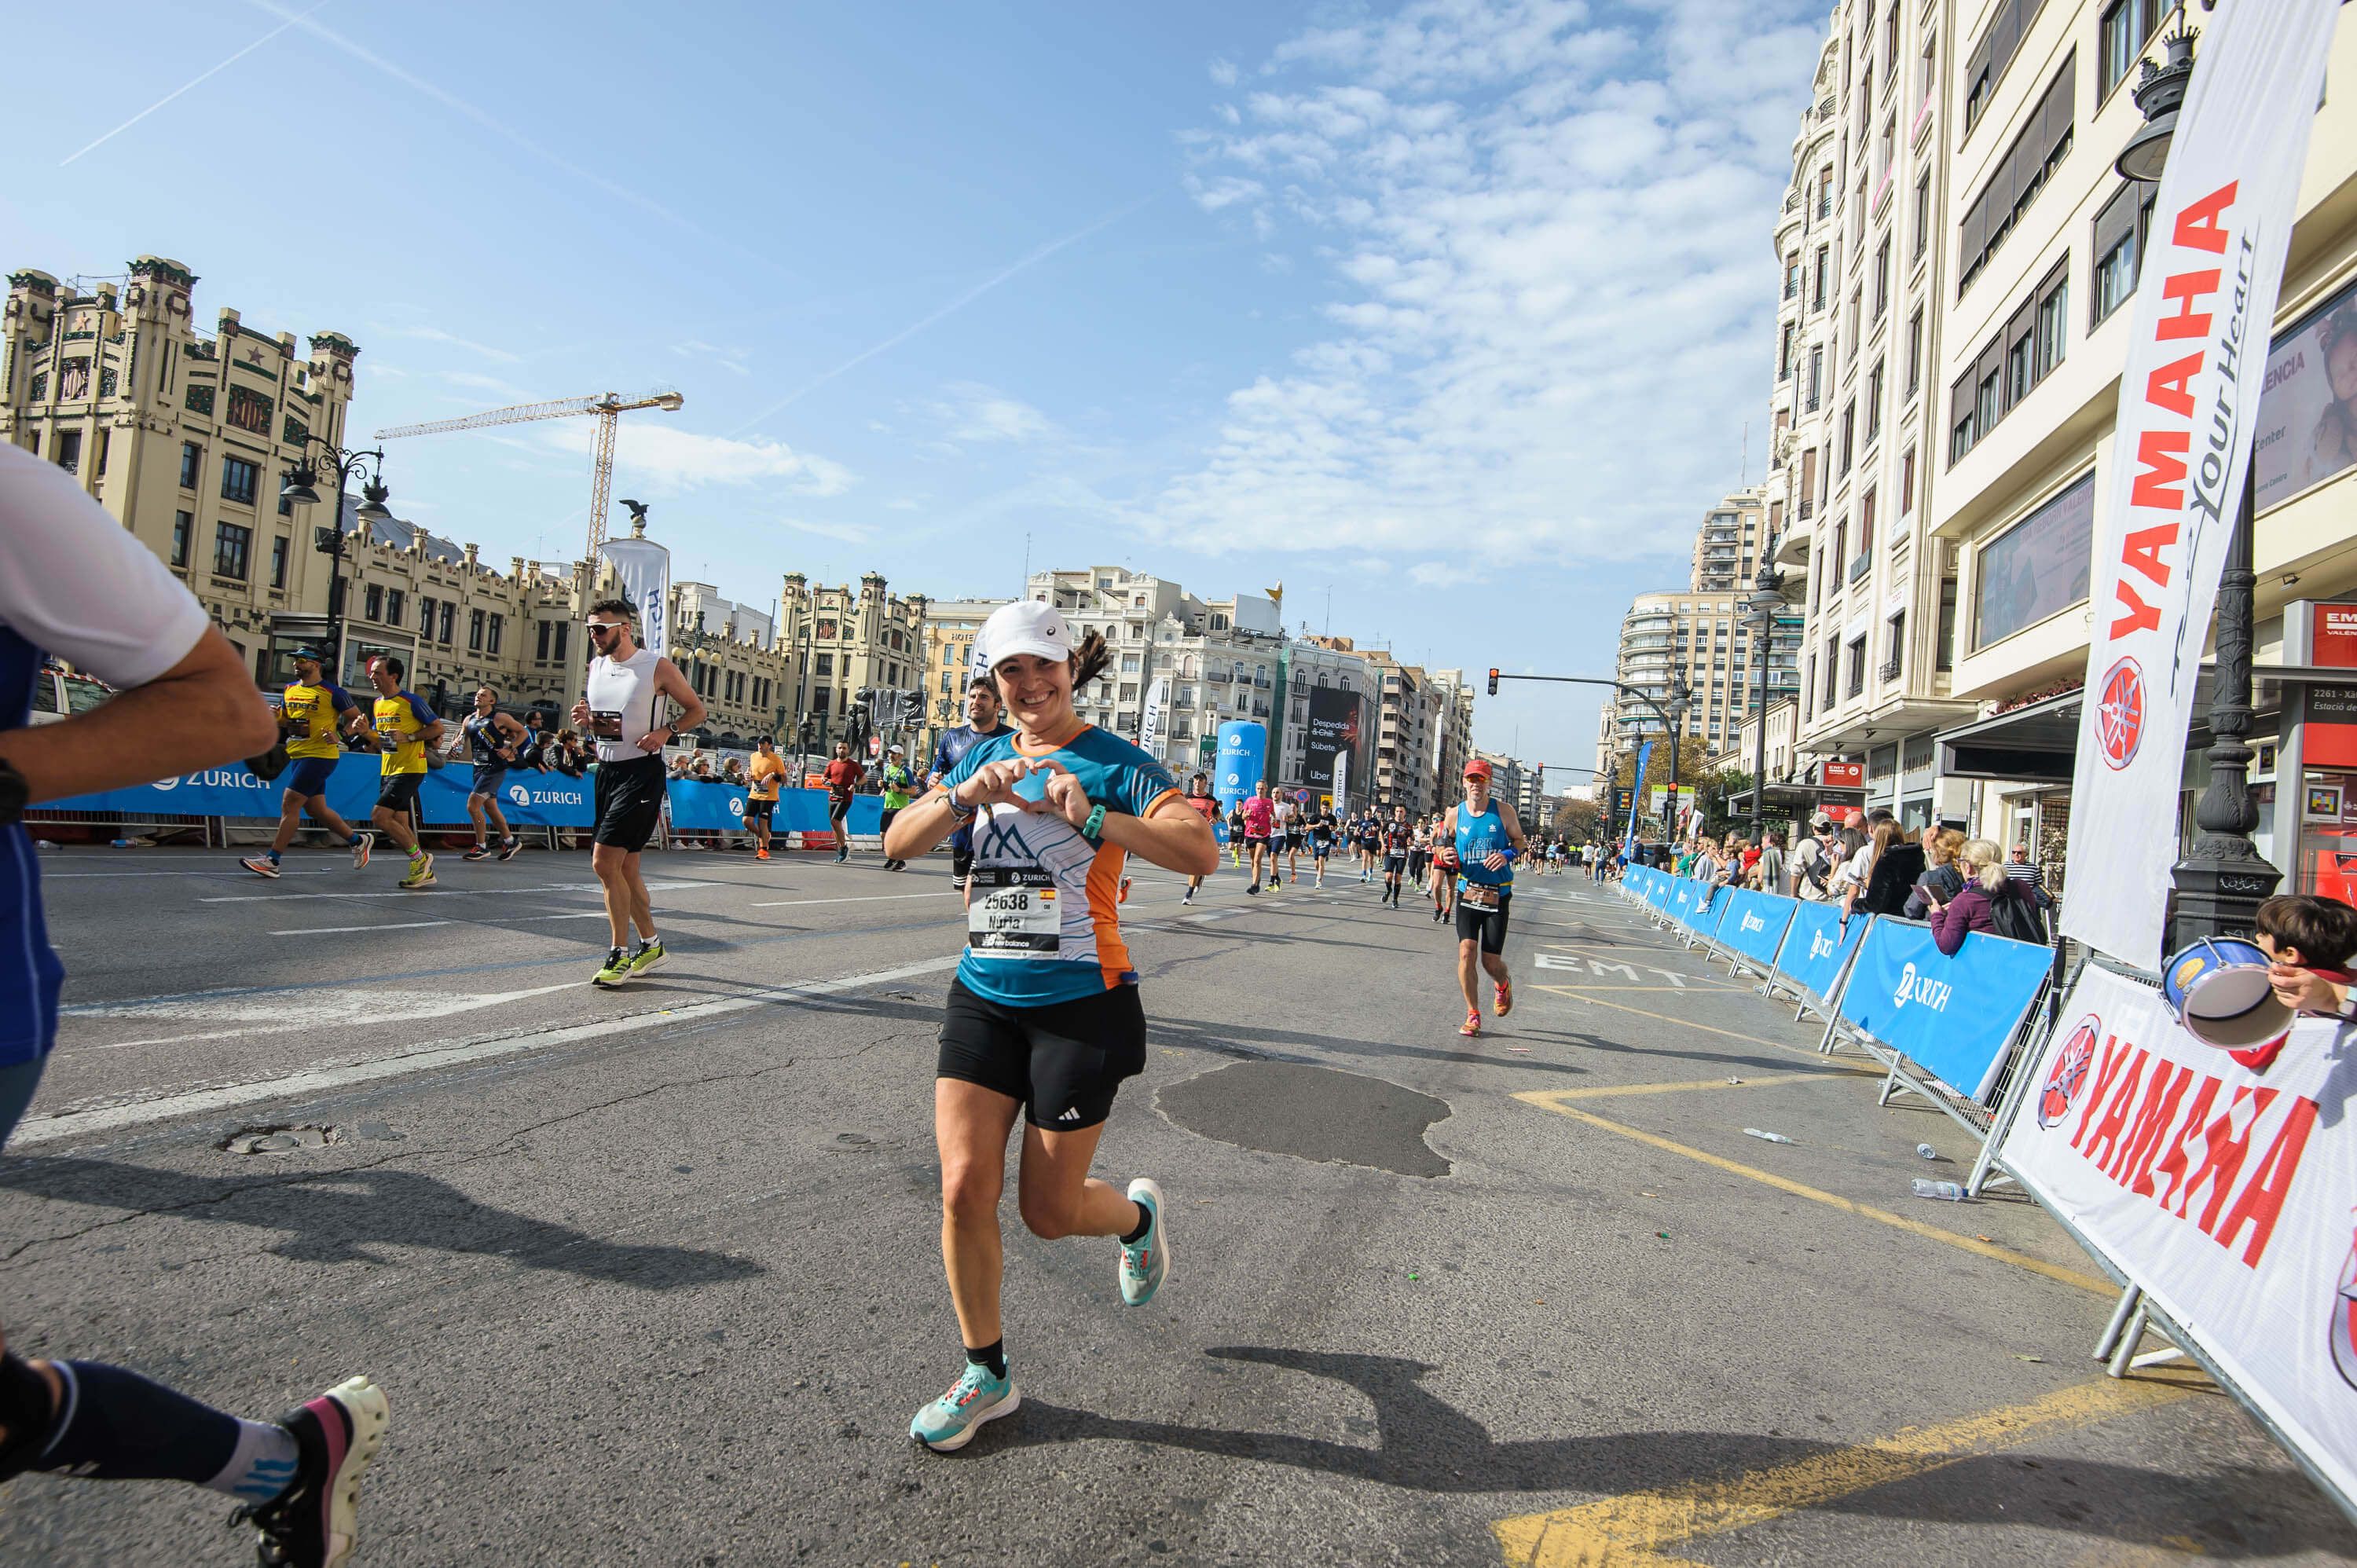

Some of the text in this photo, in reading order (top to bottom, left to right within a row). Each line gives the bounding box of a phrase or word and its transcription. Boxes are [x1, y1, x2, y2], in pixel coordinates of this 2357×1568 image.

[2218, 226, 2253, 383] Heart
[2109, 179, 2239, 641] YAMAHA
[2326, 613, 2357, 622] EM
[951, 633, 974, 642] HOTE
[2314, 689, 2336, 698] 2261
[2314, 702, 2344, 711] Estació
[1313, 718, 1350, 731] Despedida
[1222, 748, 1251, 757] ZURICH
[1310, 770, 1330, 781] Uber
[532, 790, 582, 805] ZURICH
[1219, 786, 1248, 796] ZURICH
[984, 892, 1028, 910] 25638
[988, 915, 1021, 929] Núria
[1534, 953, 1687, 988] EMT
[2069, 1034, 2321, 1270] YAMAHA
